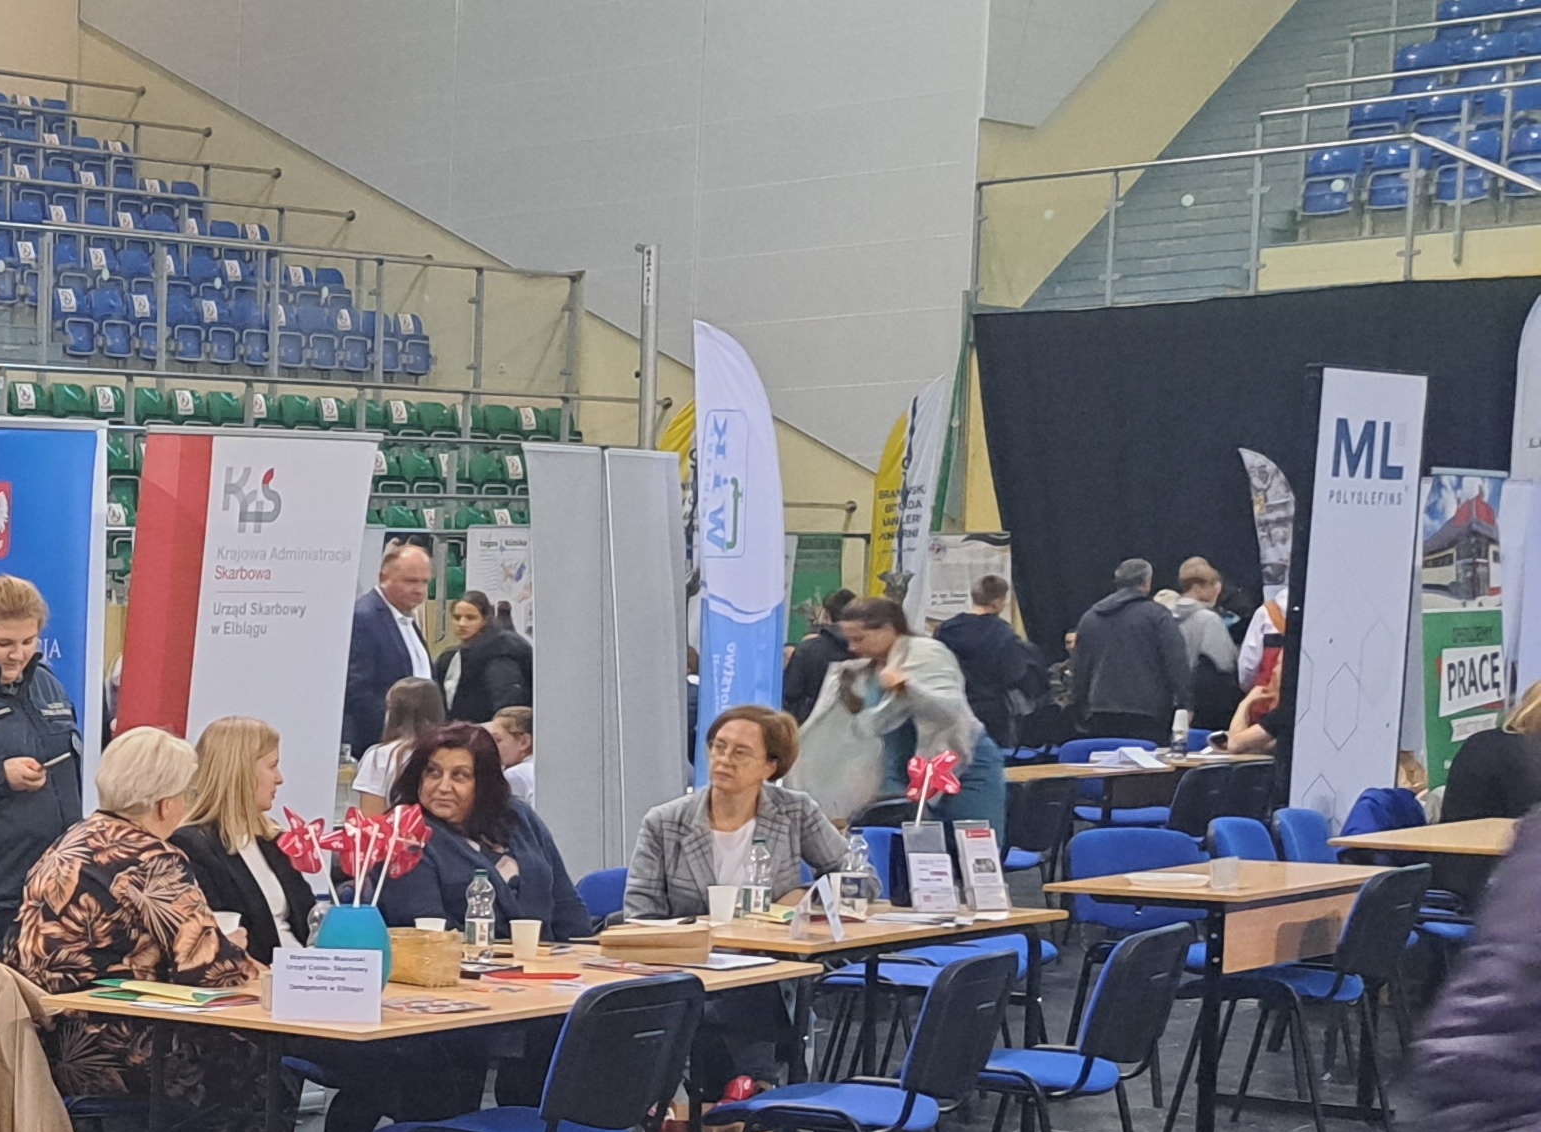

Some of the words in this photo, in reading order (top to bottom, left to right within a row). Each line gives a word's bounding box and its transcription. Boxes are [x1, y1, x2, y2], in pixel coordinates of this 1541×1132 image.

[1331, 418, 1403, 480] ML
[217, 546, 266, 562] Krajowa
[270, 547, 351, 563] Administracja
[215, 565, 271, 580] Skarbowa
[213, 603, 246, 619] Urząd
[250, 603, 306, 619] Skarbowy
[211, 624, 220, 634] w
[223, 622, 267, 637] Elblągu
[1447, 651, 1501, 701] PRACĘ
